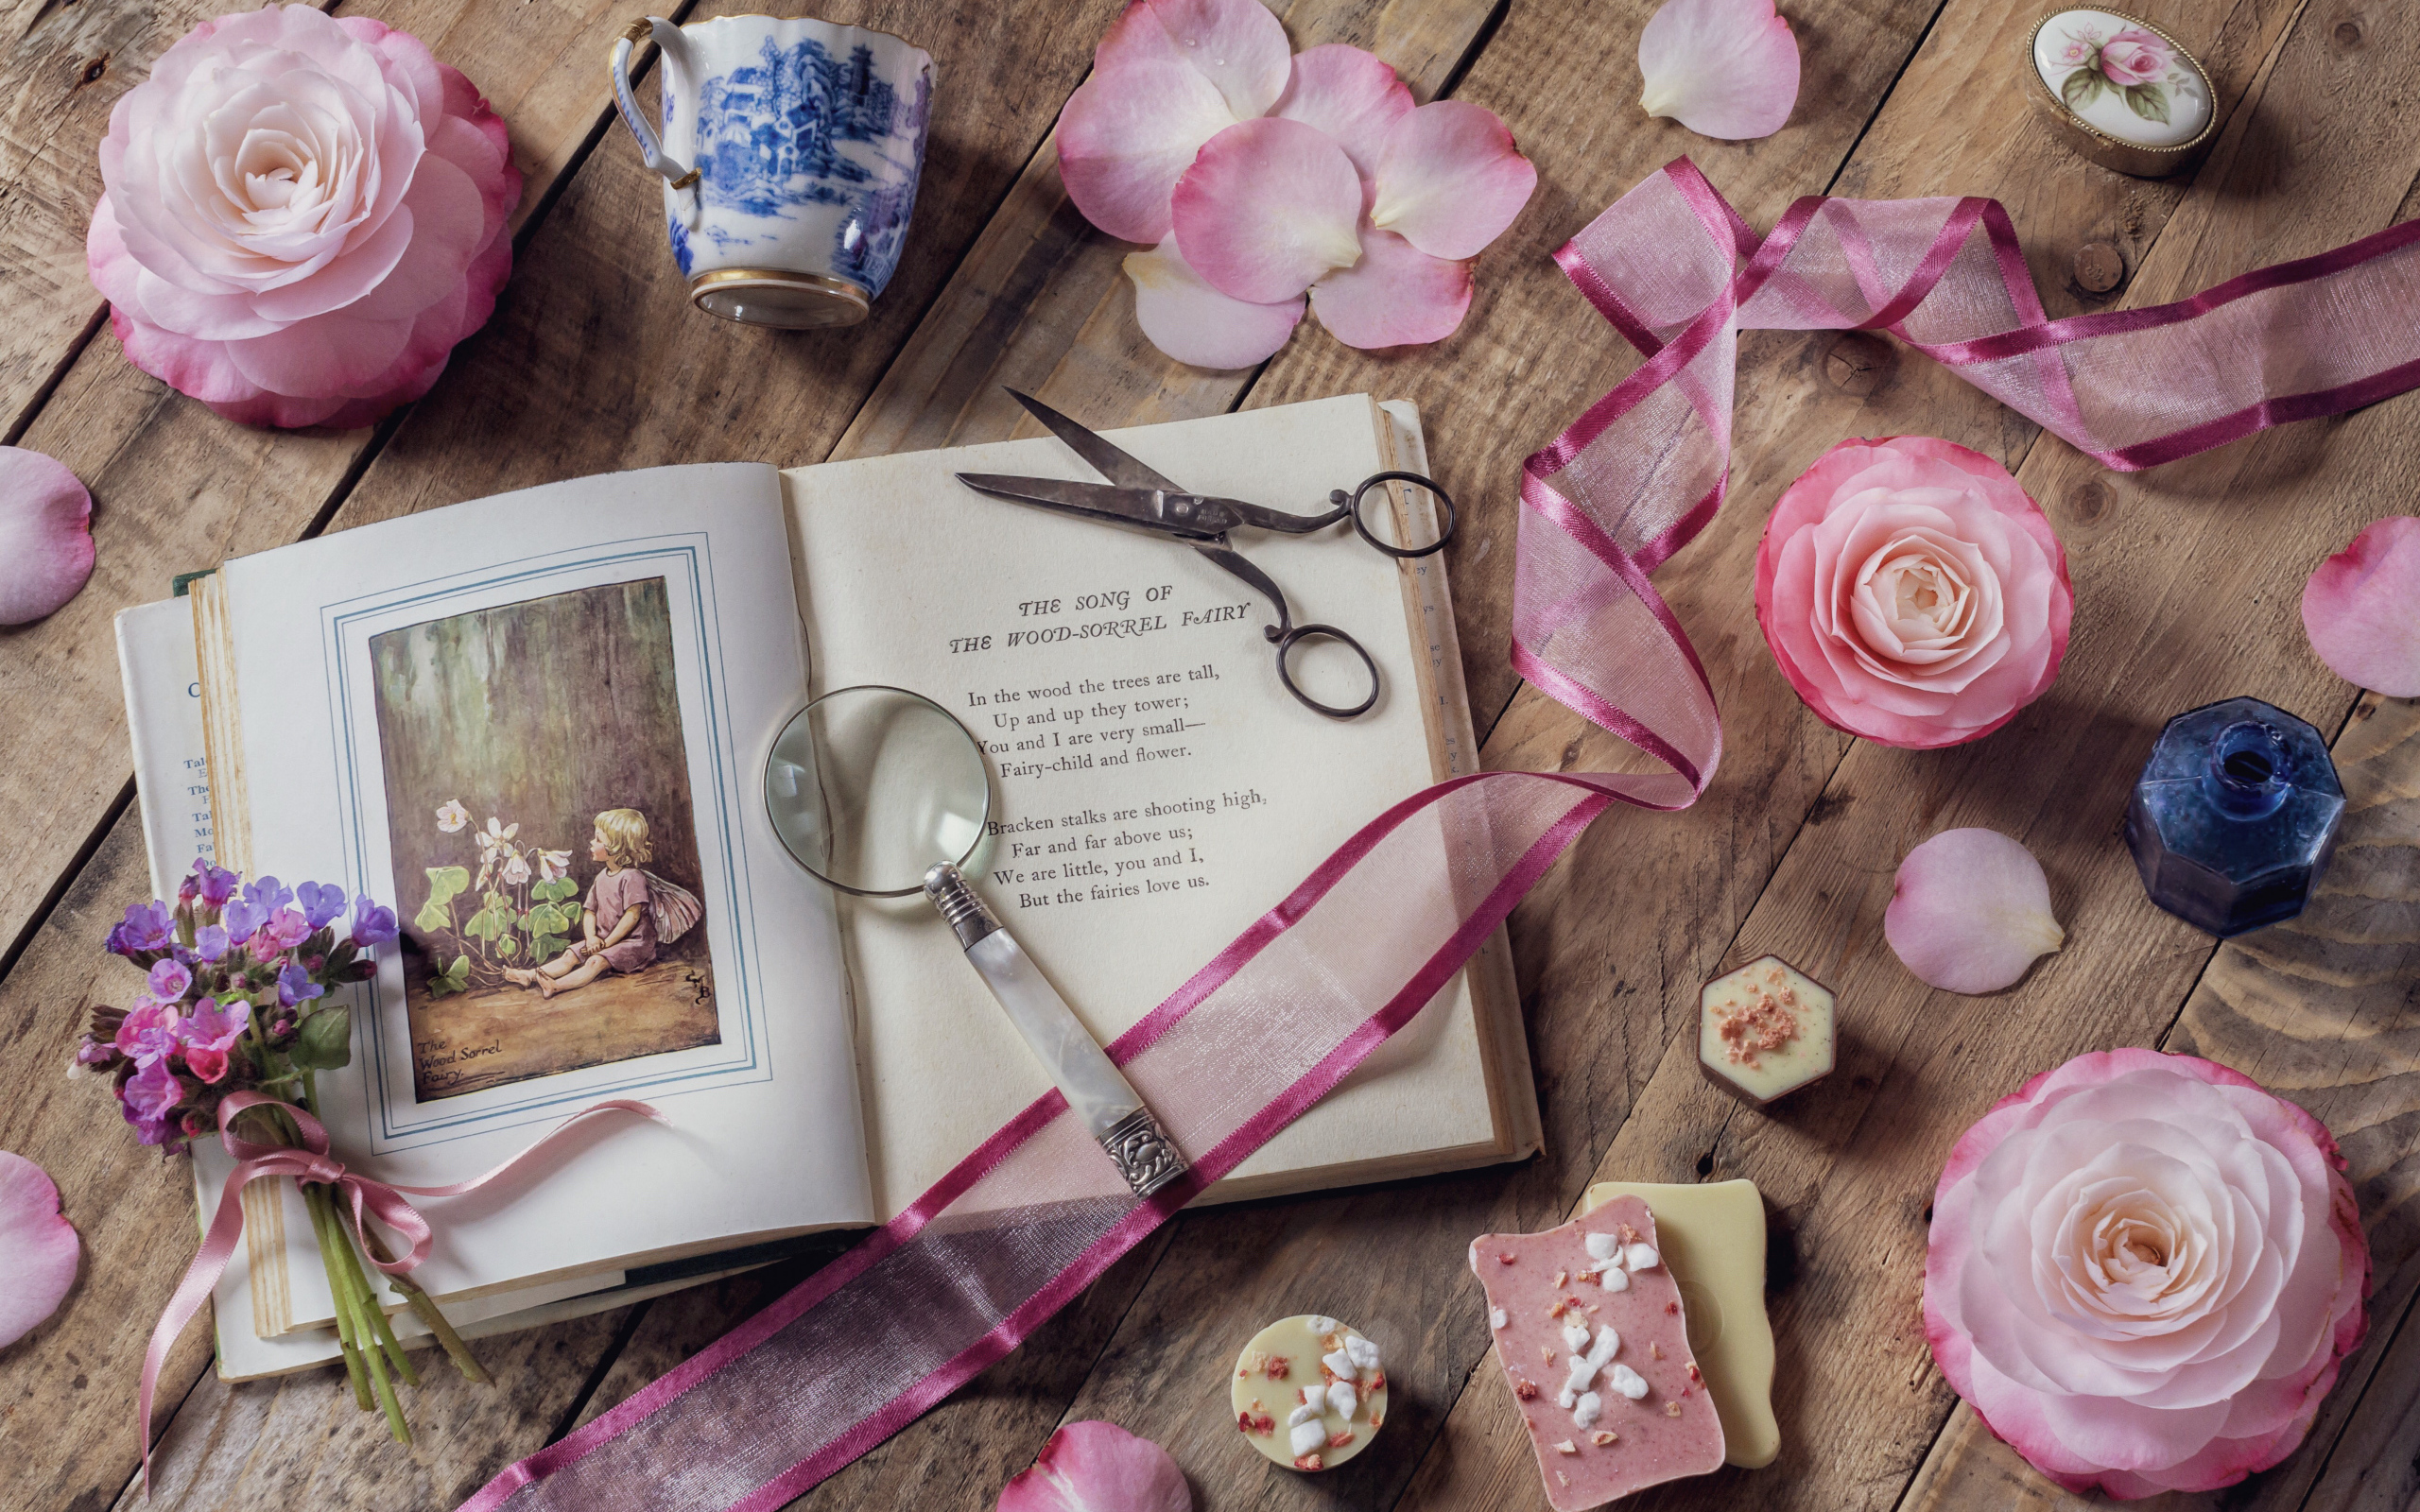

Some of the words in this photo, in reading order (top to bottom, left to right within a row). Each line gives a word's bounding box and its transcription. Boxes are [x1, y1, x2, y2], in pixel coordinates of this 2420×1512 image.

[1018, 598, 1062, 617] THE
[1075, 590, 1131, 611] SONG
[1145, 584, 1173, 603] OF
[948, 634, 993, 654] THE
[1007, 615, 1167, 647] WOOD-SORREL
[1181, 601, 1252, 627] FAIRY
[967, 692, 988, 708] In
[994, 688, 1021, 704] the
[1027, 680, 1073, 700] wood
[1078, 679, 1106, 695] the
[1112, 676, 1150, 691] trees
[1156, 673, 1182, 685] are
[1187, 663, 1220, 681] tall,
[992, 713, 1020, 732] Up
[1027, 707, 1057, 725] and
[1063, 709, 1084, 725] up
[1091, 701, 1127, 720] they
[1133, 696, 1189, 713] tower;
[976, 739, 1010, 755] You
[1015, 733, 1046, 751] and
[1051, 731, 1062, 747] I
[1067, 733, 1094, 746] are
[1099, 728, 1135, 745] very
[999, 752, 1095, 780] Fairy-child
[1099, 748, 1130, 767] and
[1135, 747, 1192, 763] flower.
[986, 816, 1054, 837] Bracken
[1061, 809, 1107, 828] stalks
[1113, 809, 1138, 821] are
[1144, 797, 1217, 817] shooting
[1221, 788, 1267, 810] high,
[1011, 842, 1042, 859] Far
[1047, 836, 1078, 854] and
[1084, 833, 1108, 850] far
[1114, 830, 1162, 847] above
[1167, 828, 1193, 841] us;
[993, 868, 1025, 885] We
[1030, 869, 1057, 882] are
[1062, 859, 1109, 878] little,
[1114, 859, 1147, 878] you
[1152, 850, 1183, 868] and
[1188, 847, 1204, 864] I,
[1018, 893, 1050, 909] But
[1056, 887, 1084, 904] the
[1090, 882, 1140, 901] fairies
[1145, 879, 1181, 894] love
[1186, 876, 1210, 888] us.
[417, 1040, 447, 1055] The
[420, 1049, 457, 1071] Wood
[459, 1039, 503, 1061] Sorrel
